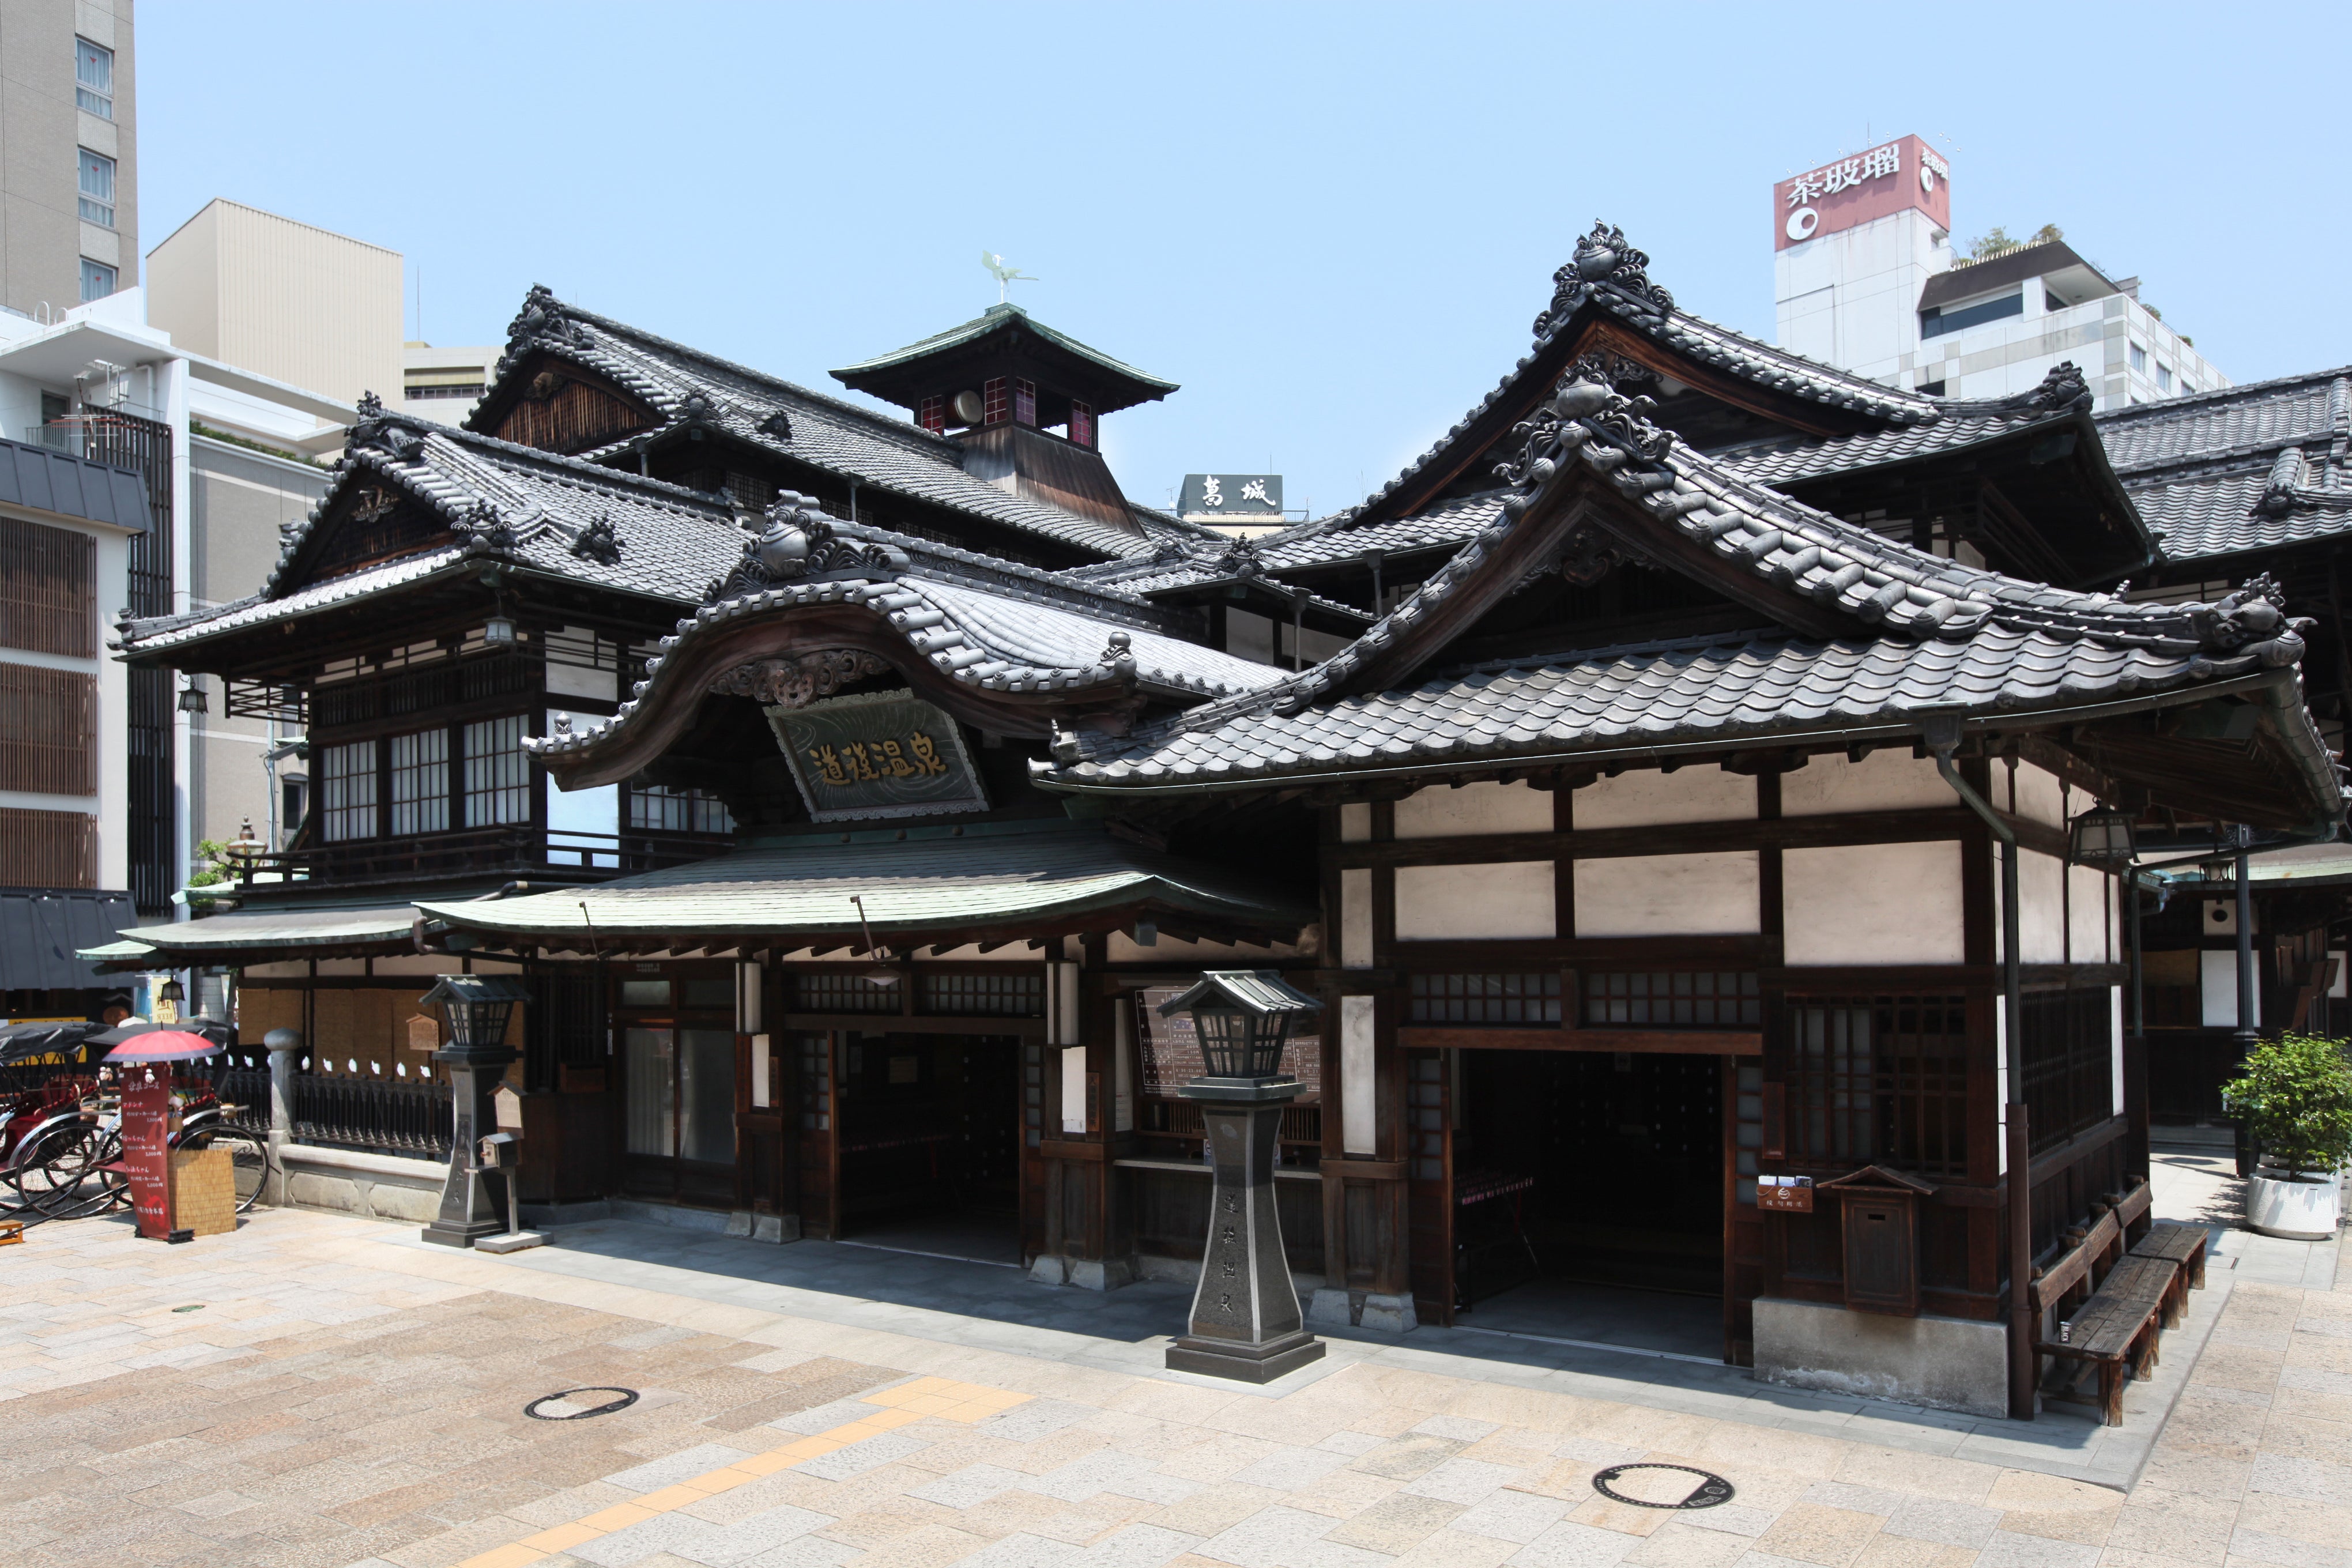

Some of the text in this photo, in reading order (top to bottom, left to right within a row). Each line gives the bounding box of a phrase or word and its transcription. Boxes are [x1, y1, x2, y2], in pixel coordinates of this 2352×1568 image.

[1786, 144, 1900, 208] 茶玻瑠
[1921, 146, 1948, 180] 茶玻瑠
[1203, 474, 1276, 507] 葛城
[809, 731, 947, 786] 道後温泉
